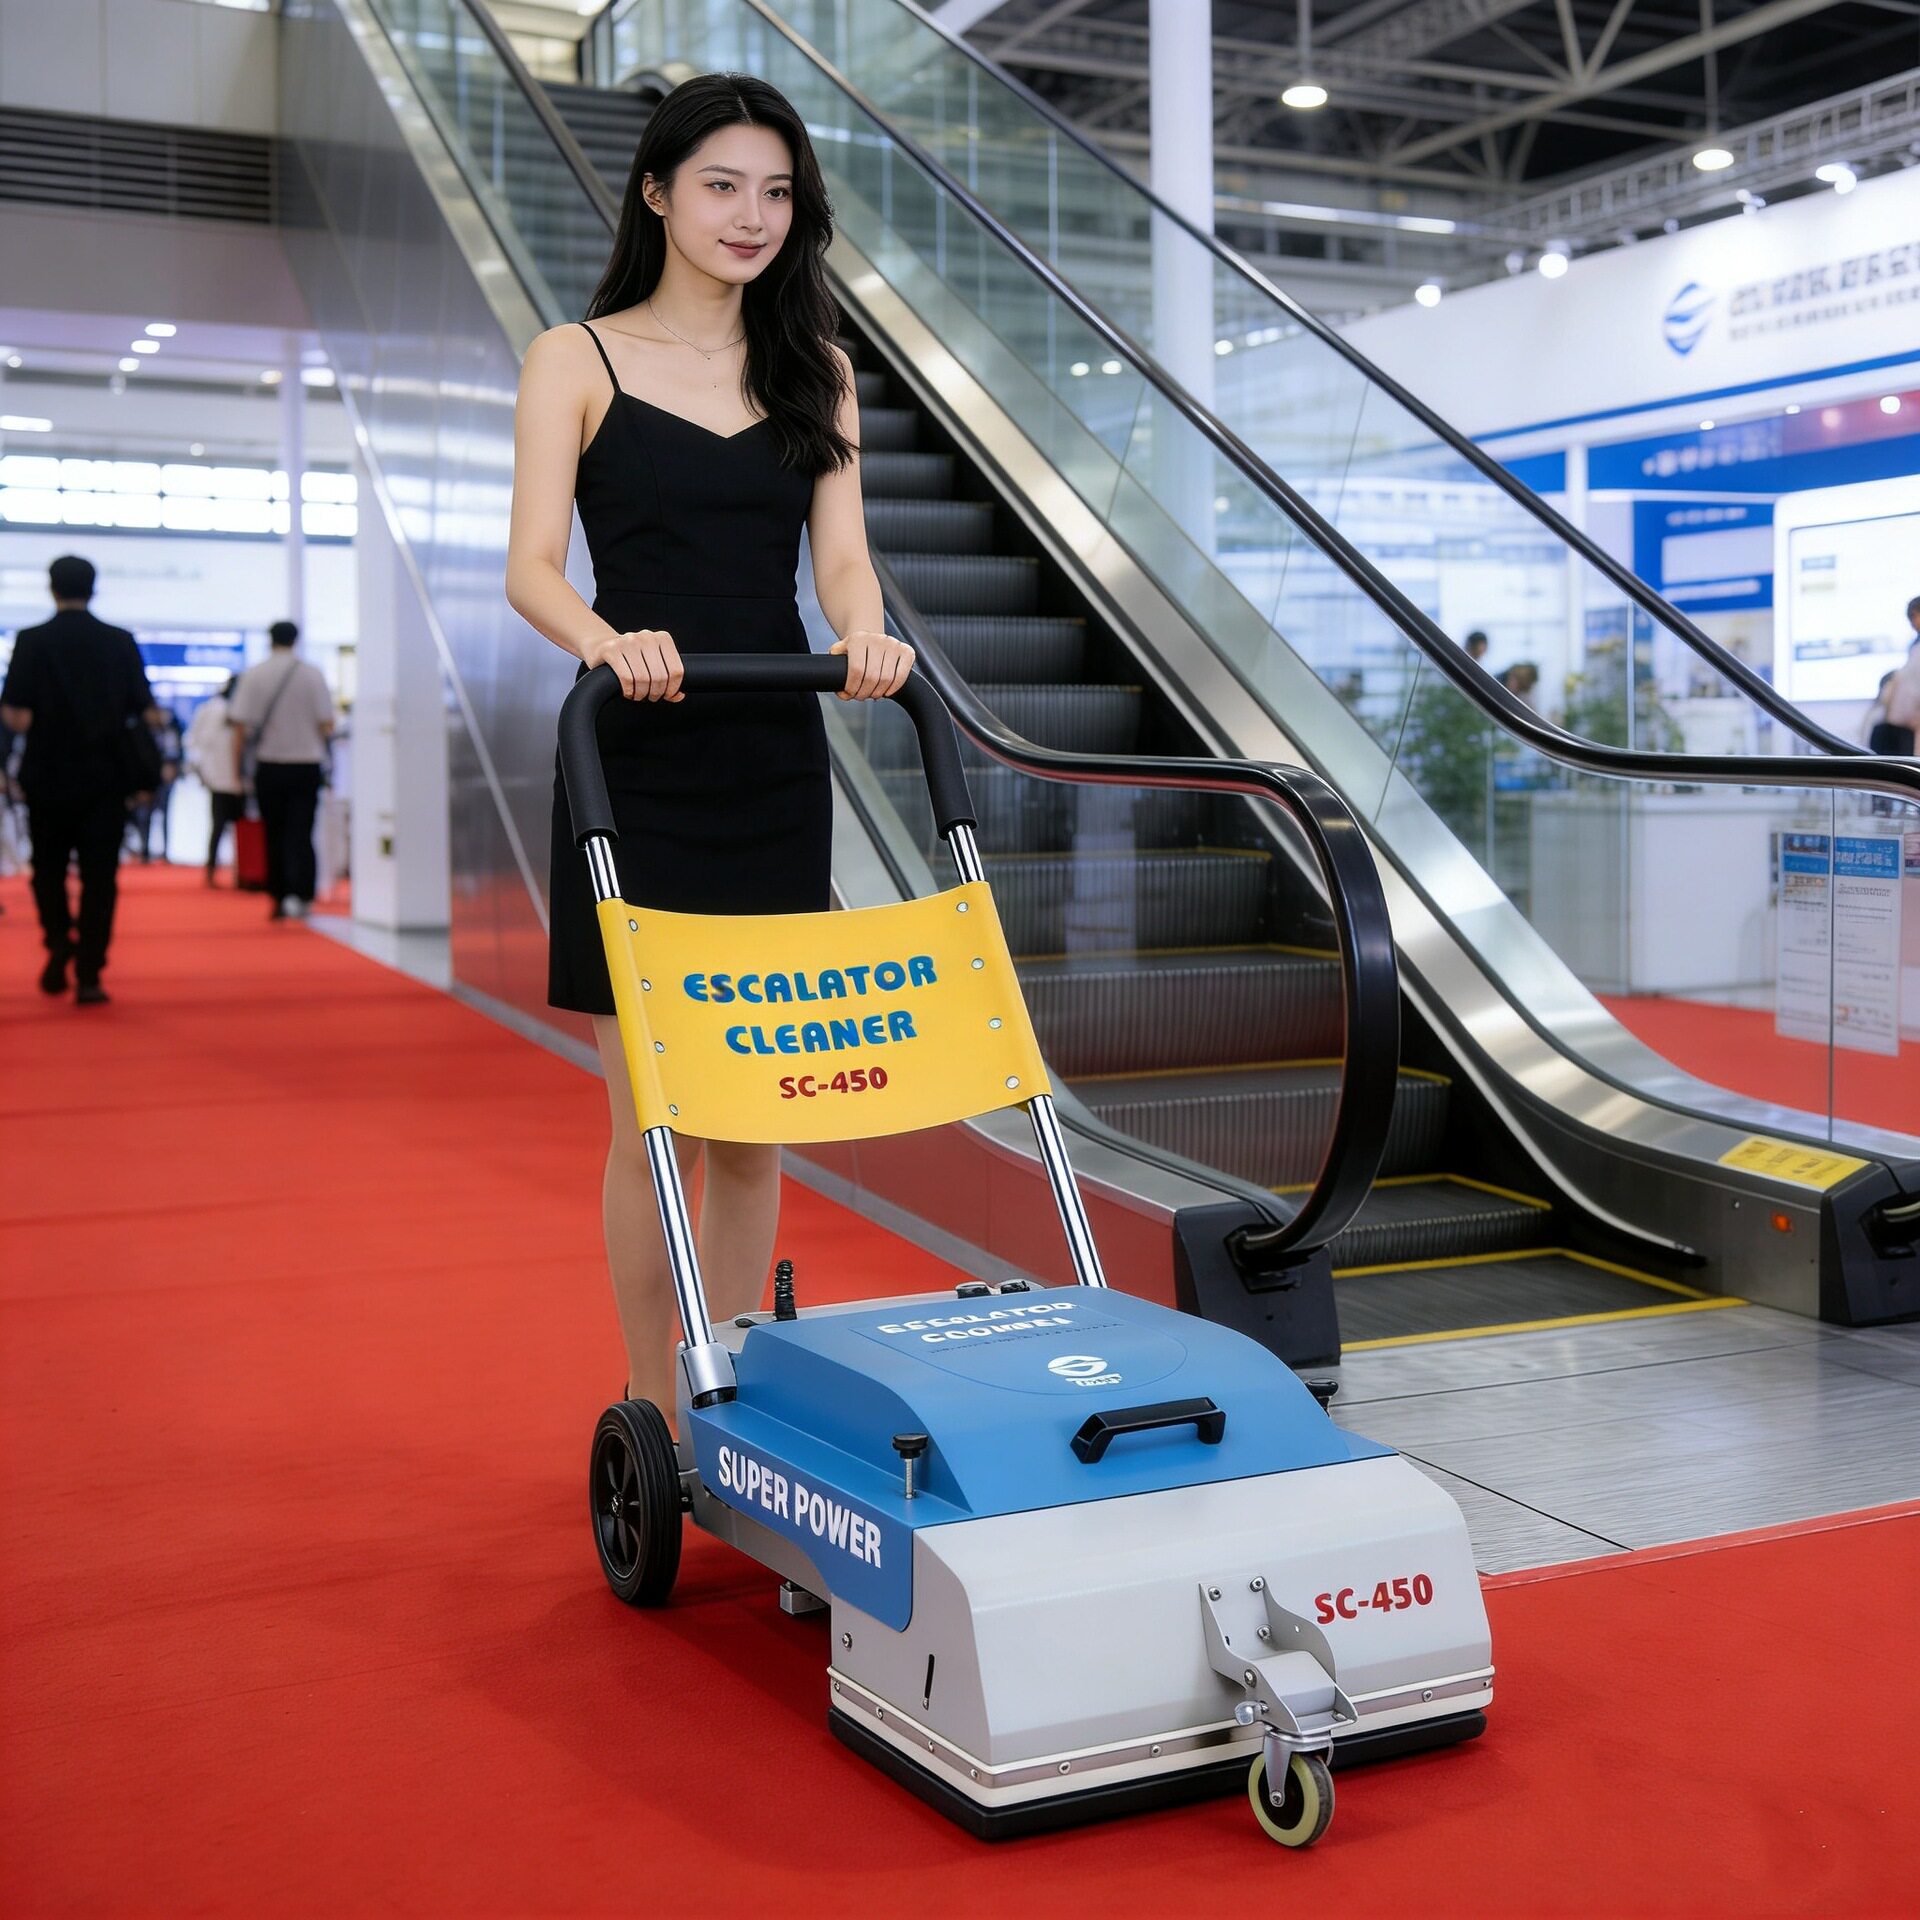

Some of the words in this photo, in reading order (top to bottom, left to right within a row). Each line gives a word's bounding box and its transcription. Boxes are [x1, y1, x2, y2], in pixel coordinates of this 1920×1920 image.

[683, 955, 937, 1004] ESCALATOR
[725, 1010, 917, 1055] CLEANER
[779, 1066, 888, 1100] SC-450
[718, 1445, 789, 1520] SUPER
[794, 1482, 881, 1569] POWER
[1314, 1573, 1433, 1625] SC-450
